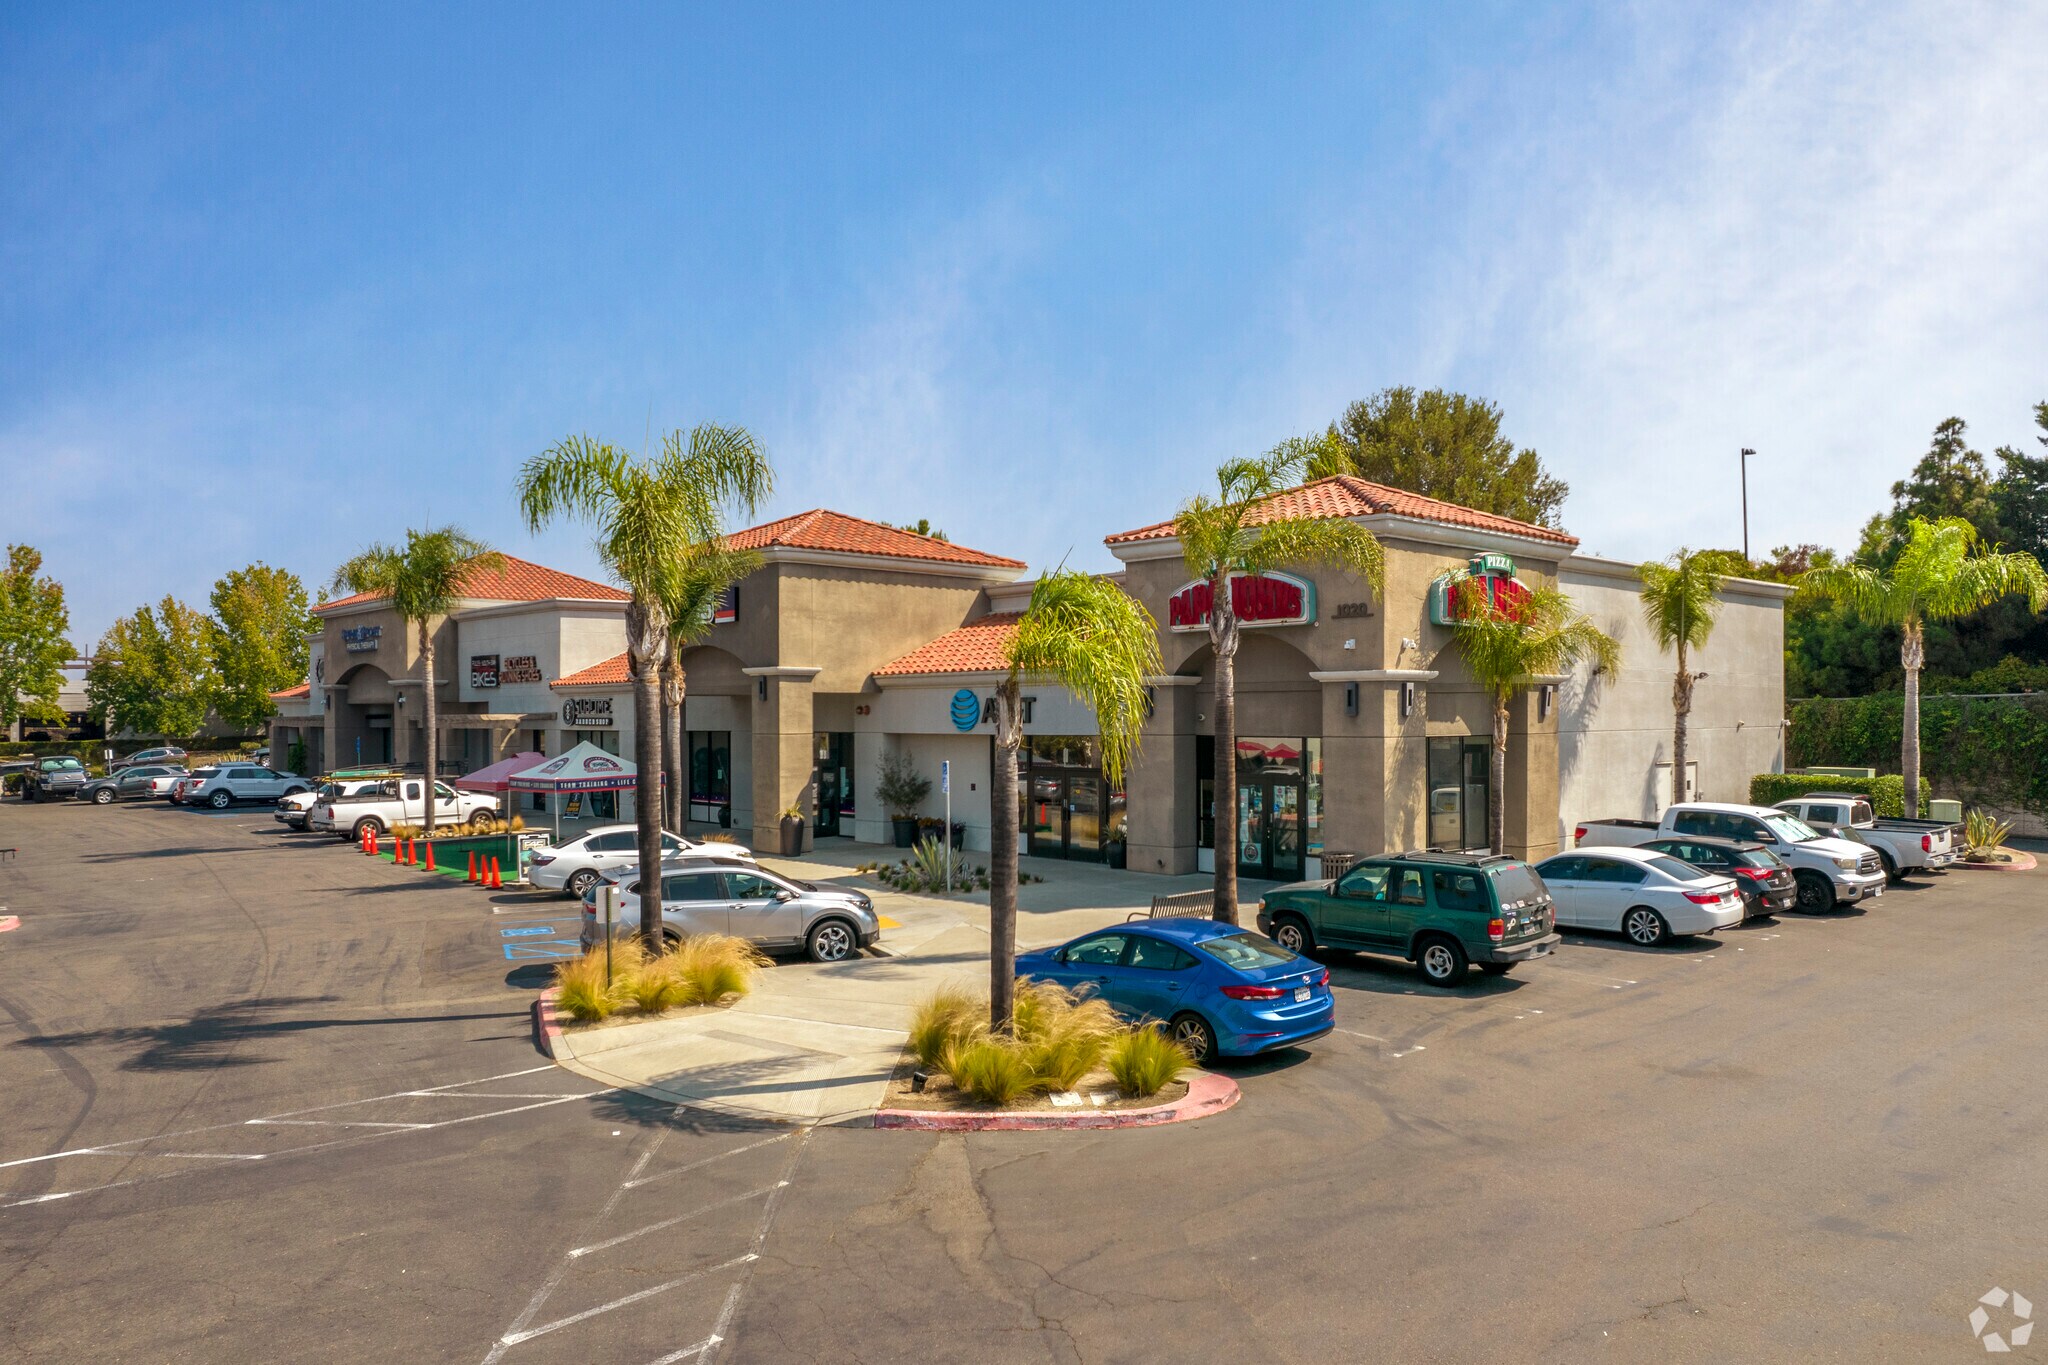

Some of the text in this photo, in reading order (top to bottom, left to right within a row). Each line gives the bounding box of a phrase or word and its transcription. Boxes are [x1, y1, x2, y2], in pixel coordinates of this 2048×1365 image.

[1487, 555, 1511, 569] PIZZA
[1337, 602, 1367, 617] 1020
[472, 672, 497, 687] BIKES
[579, 780, 608, 788] TRAINING
